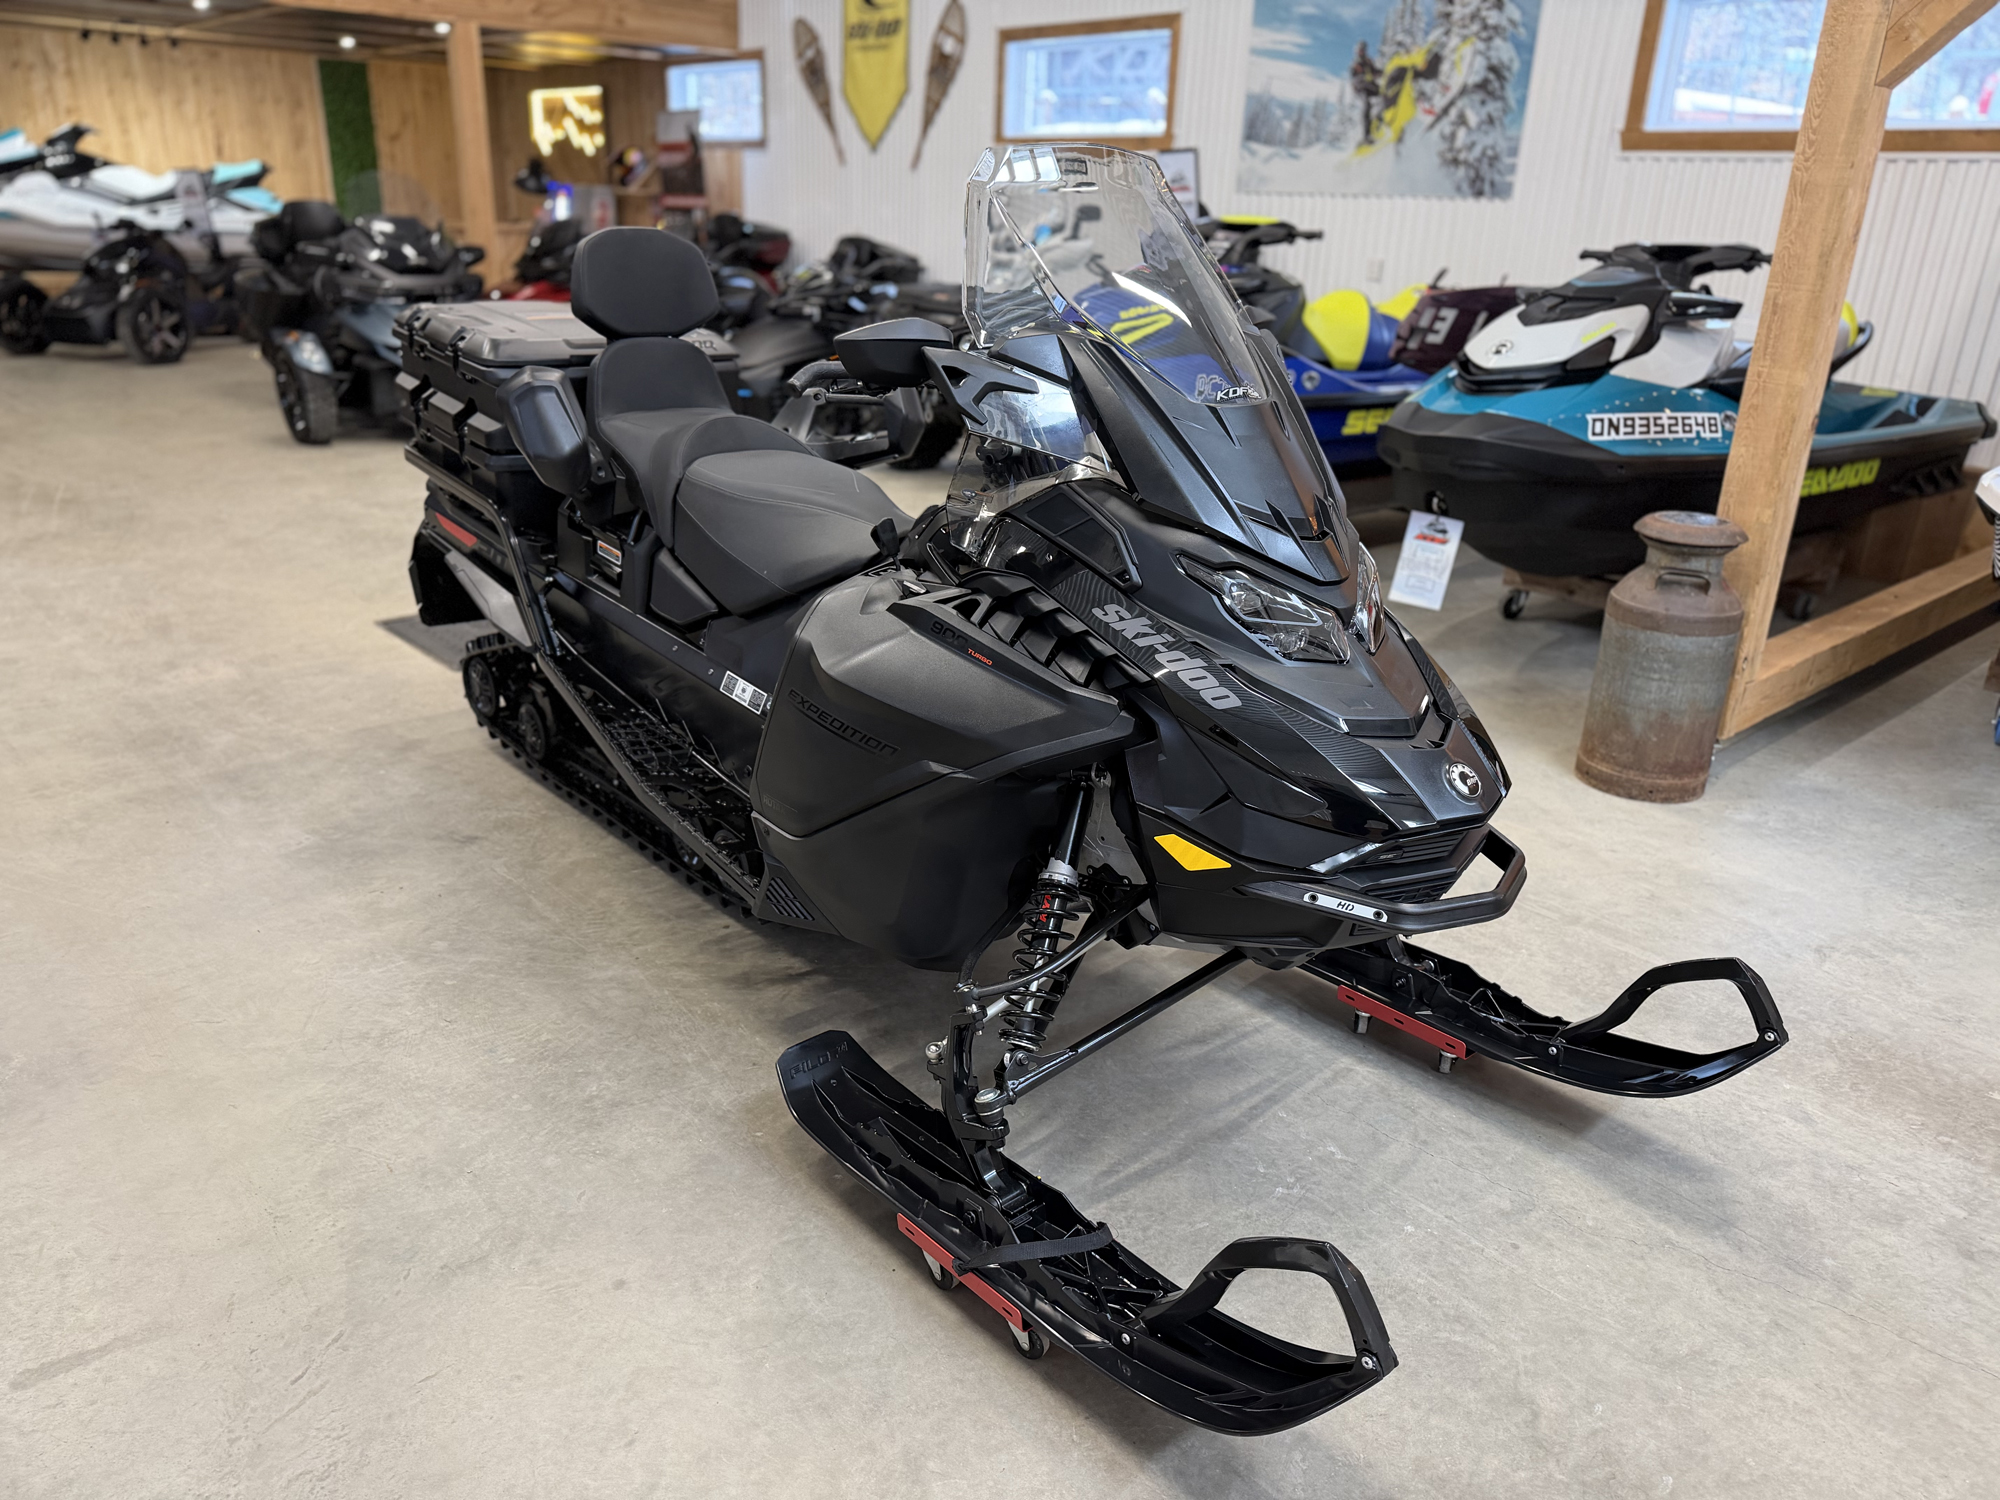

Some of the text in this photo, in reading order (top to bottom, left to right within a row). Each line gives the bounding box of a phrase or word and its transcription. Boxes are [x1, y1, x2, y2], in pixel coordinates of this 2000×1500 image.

[968, 647, 993, 666] TURBO
[787, 688, 900, 757] EXPEDITION
[1336, 901, 1355, 912] HD
